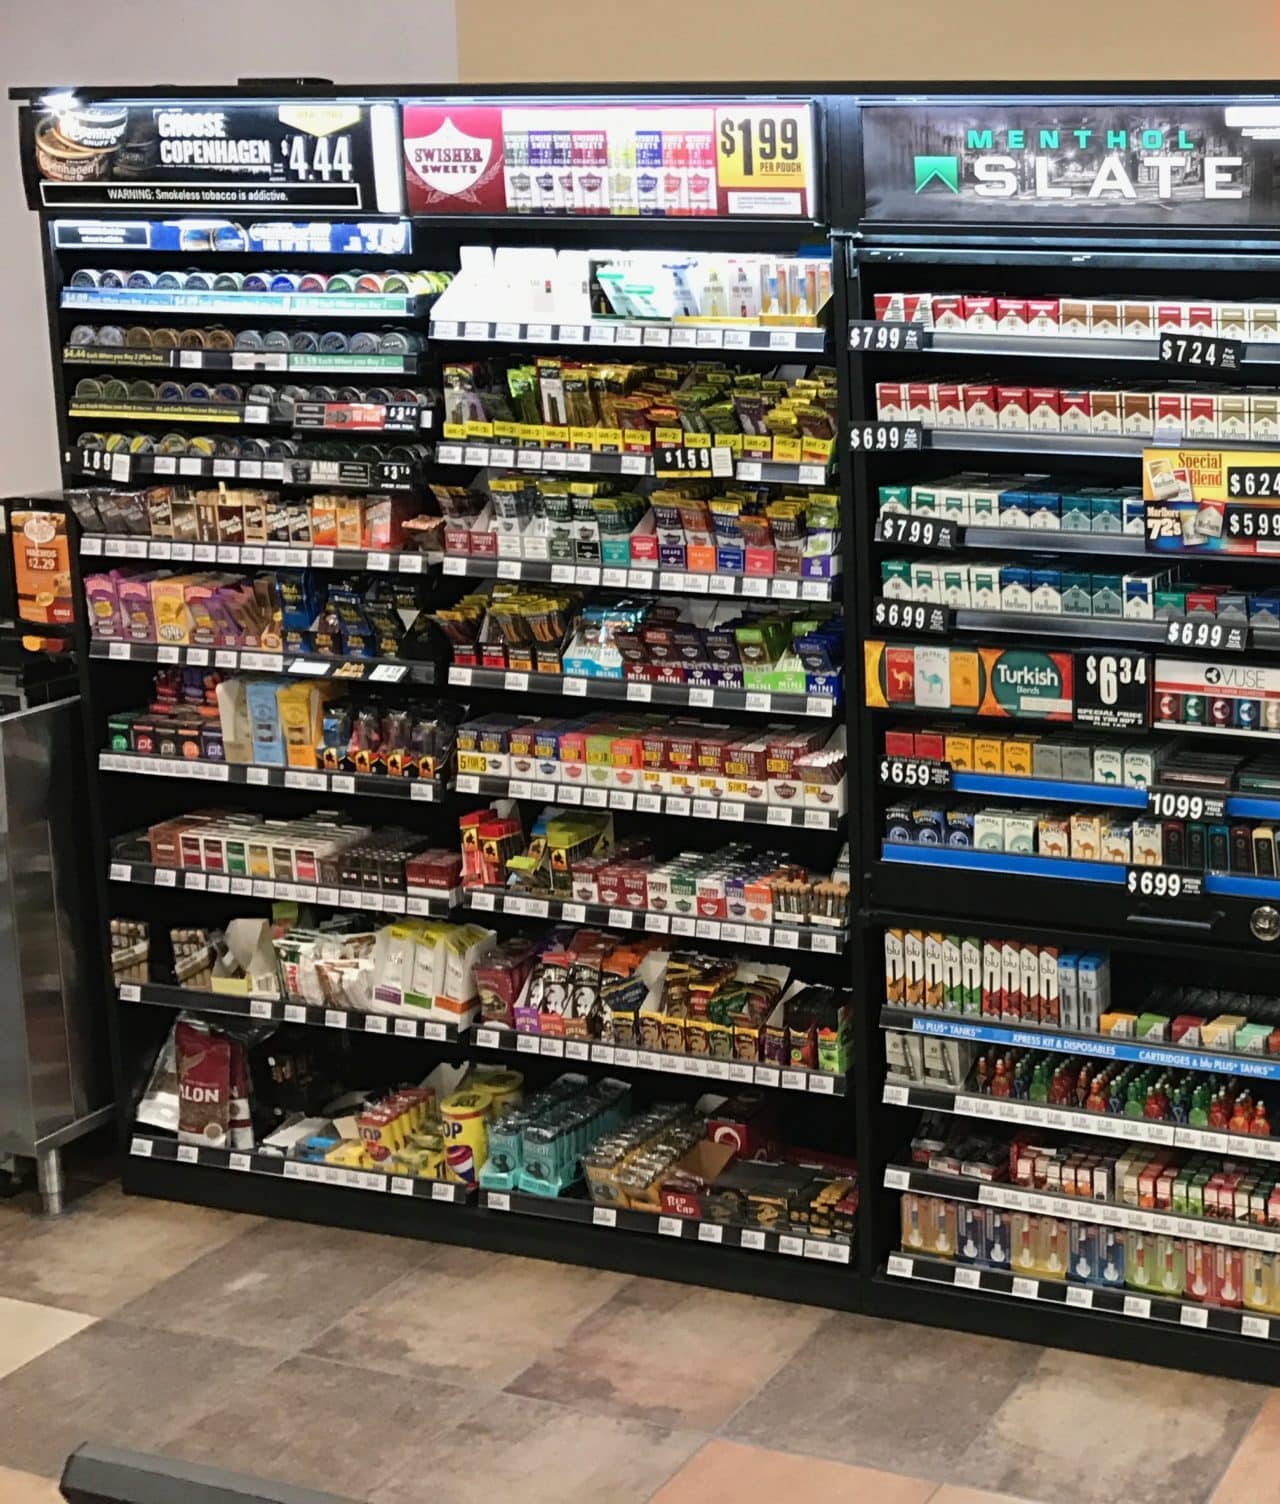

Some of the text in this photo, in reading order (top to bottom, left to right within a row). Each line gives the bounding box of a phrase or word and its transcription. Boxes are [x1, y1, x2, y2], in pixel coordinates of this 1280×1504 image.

[158, 112, 227, 138] CHOOSE
[967, 129, 1195, 149] MENTHOL
[160, 140, 271, 164] COPENHAGEN
[281, 135, 353, 181] $4.44
[414, 148, 483, 164] SWISHER
[421, 164, 477, 174] SWEETS
[760, 163, 801, 173] PER POUCH
[973, 155, 1243, 199] SLATE
[107, 188, 288, 202] WARNING: Smokeless tobacco is addictive.
[850, 327, 900, 351] $7.99
[1162, 338, 1217, 366] $7.24
[850, 427, 900, 450] $6.99
[665, 449, 710, 470] $1.59
[1178, 452, 1222, 470] Special
[1190, 470, 1222, 487] Blend
[883, 518, 934, 544] $7.99
[875, 603, 926, 629] $6.99
[1167, 620, 1222, 647] $6.99
[627, 672, 651, 681] MINI
[657, 674, 681, 684] MINI
[687, 677, 712, 686] MINI
[717, 679, 743, 689] MINI
[997, 663, 1058, 687] Turkish
[1221, 669, 1266, 689] VUSE
[1017, 686, 1041, 695] Blends
[881, 761, 930, 786] $6.59
[1128, 872, 1181, 897] $6.99
[1013, 1034, 1042, 1046] XPRESS
[1043, 1037, 1055, 1047] KIT
[1063, 1039, 1116, 1056] DISPOSABLES
[1139, 1050, 1190, 1066] CARTRIDGES
